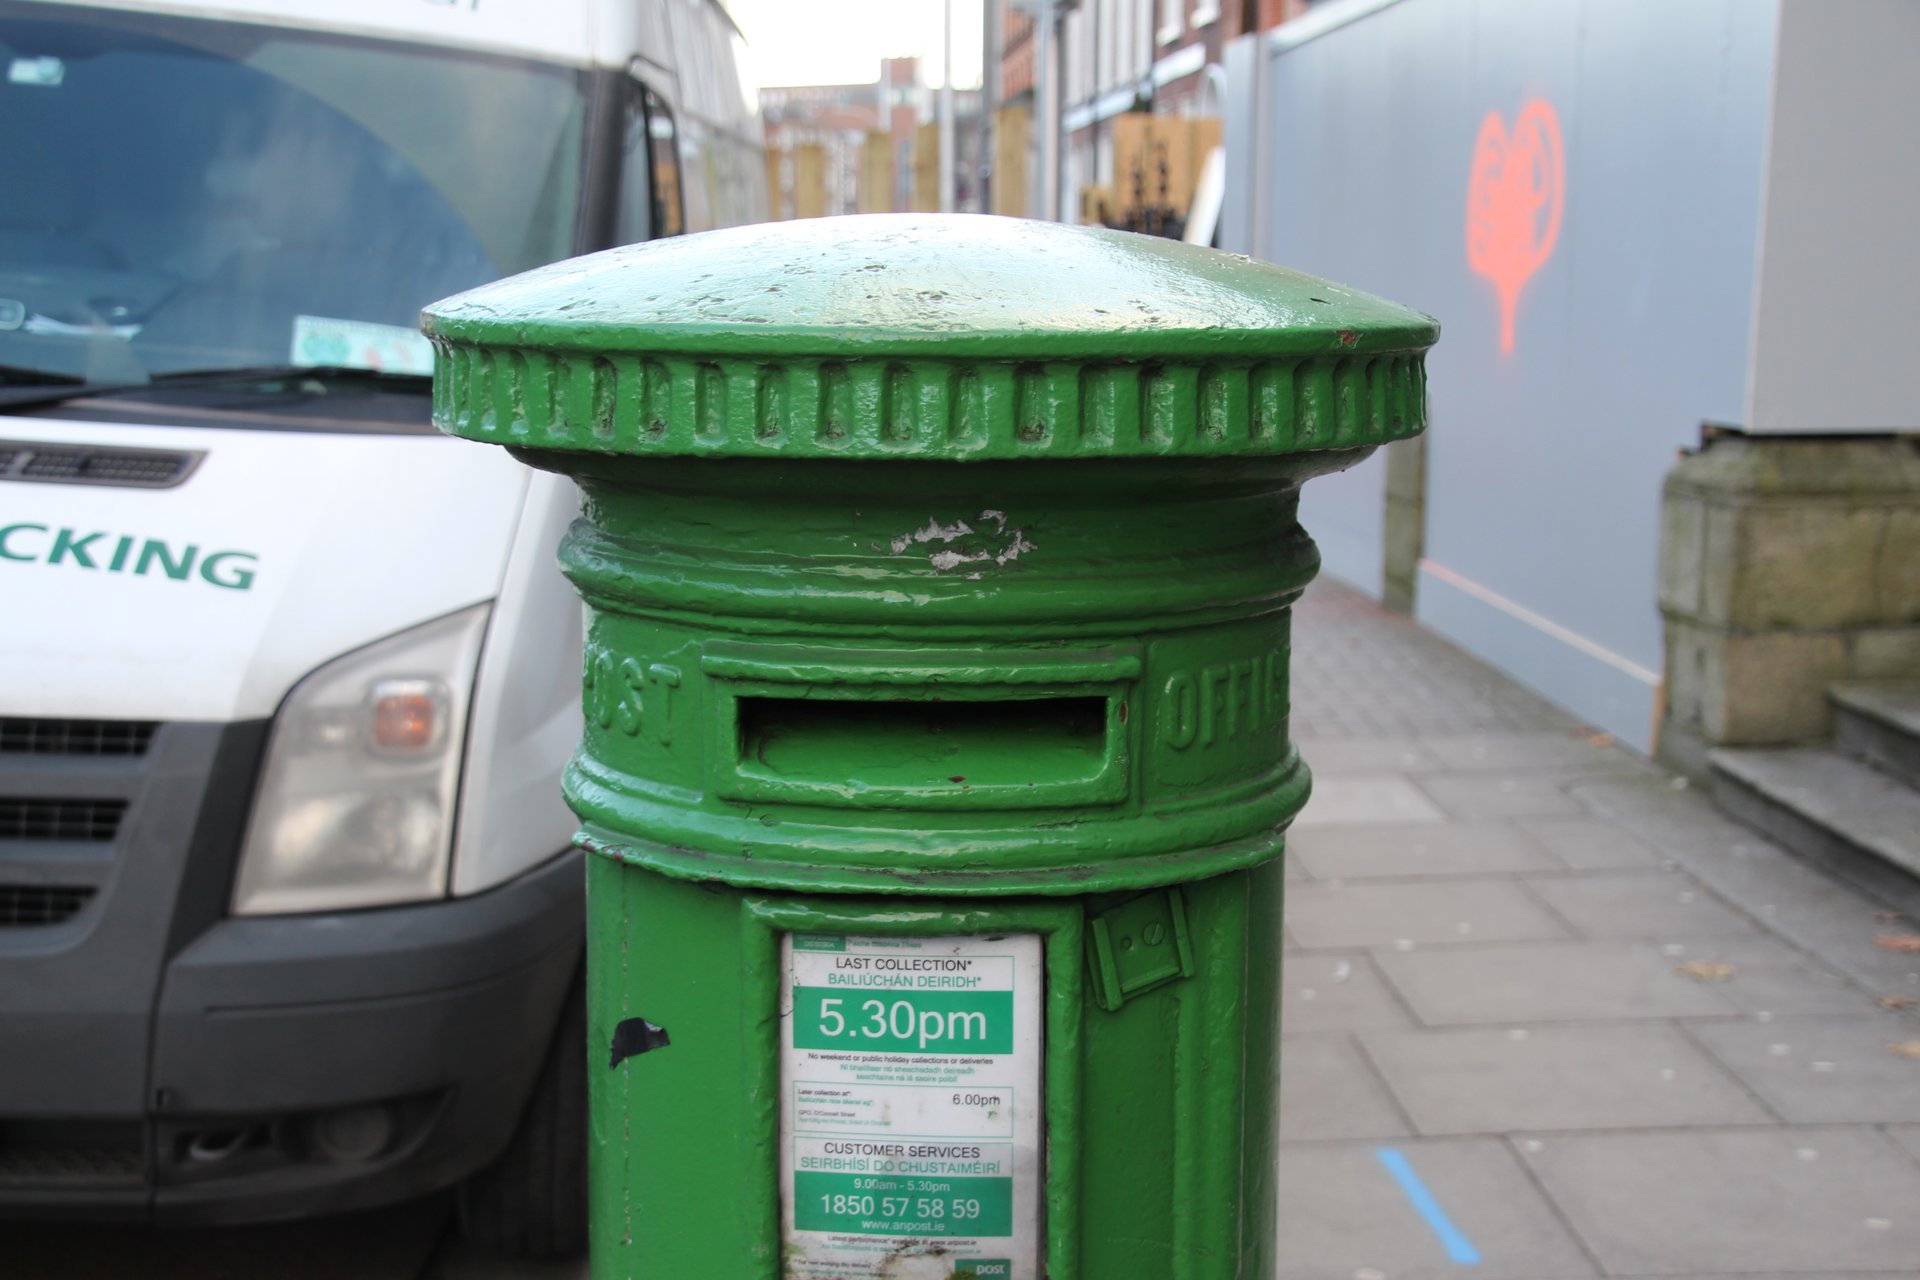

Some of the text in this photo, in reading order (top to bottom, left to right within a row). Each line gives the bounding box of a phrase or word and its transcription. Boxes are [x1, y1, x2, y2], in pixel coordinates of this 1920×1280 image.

[0, 521, 260, 590] CKING
[835, 956, 871, 970] LAST
[828, 971, 914, 987] BAILIÚCHÁN
[818, 998, 987, 1049] 5.30pm
[808, 1052, 818, 1060] No
[820, 1053, 852, 1061] weekend
[862, 1055, 883, 1064] public
[884, 1055, 910, 1065] holiday
[911, 1056, 949, 1065] collections
[952, 1093, 1001, 1108] 6.00pm
[824, 1142, 980, 1159] CUSTOMER SERVICES
[801, 1156, 870, 1171] SEIRBHÍSÍ
[898, 1159, 1001, 1175] CHUSTAIMÉIRÍ
[853, 1177, 897, 1191] 9.00am
[907, 1180, 951, 1194] 5.30pm
[820, 1194, 981, 1219] 1850 57 58 59
[862, 1218, 945, 1233] www.anpost.ie
